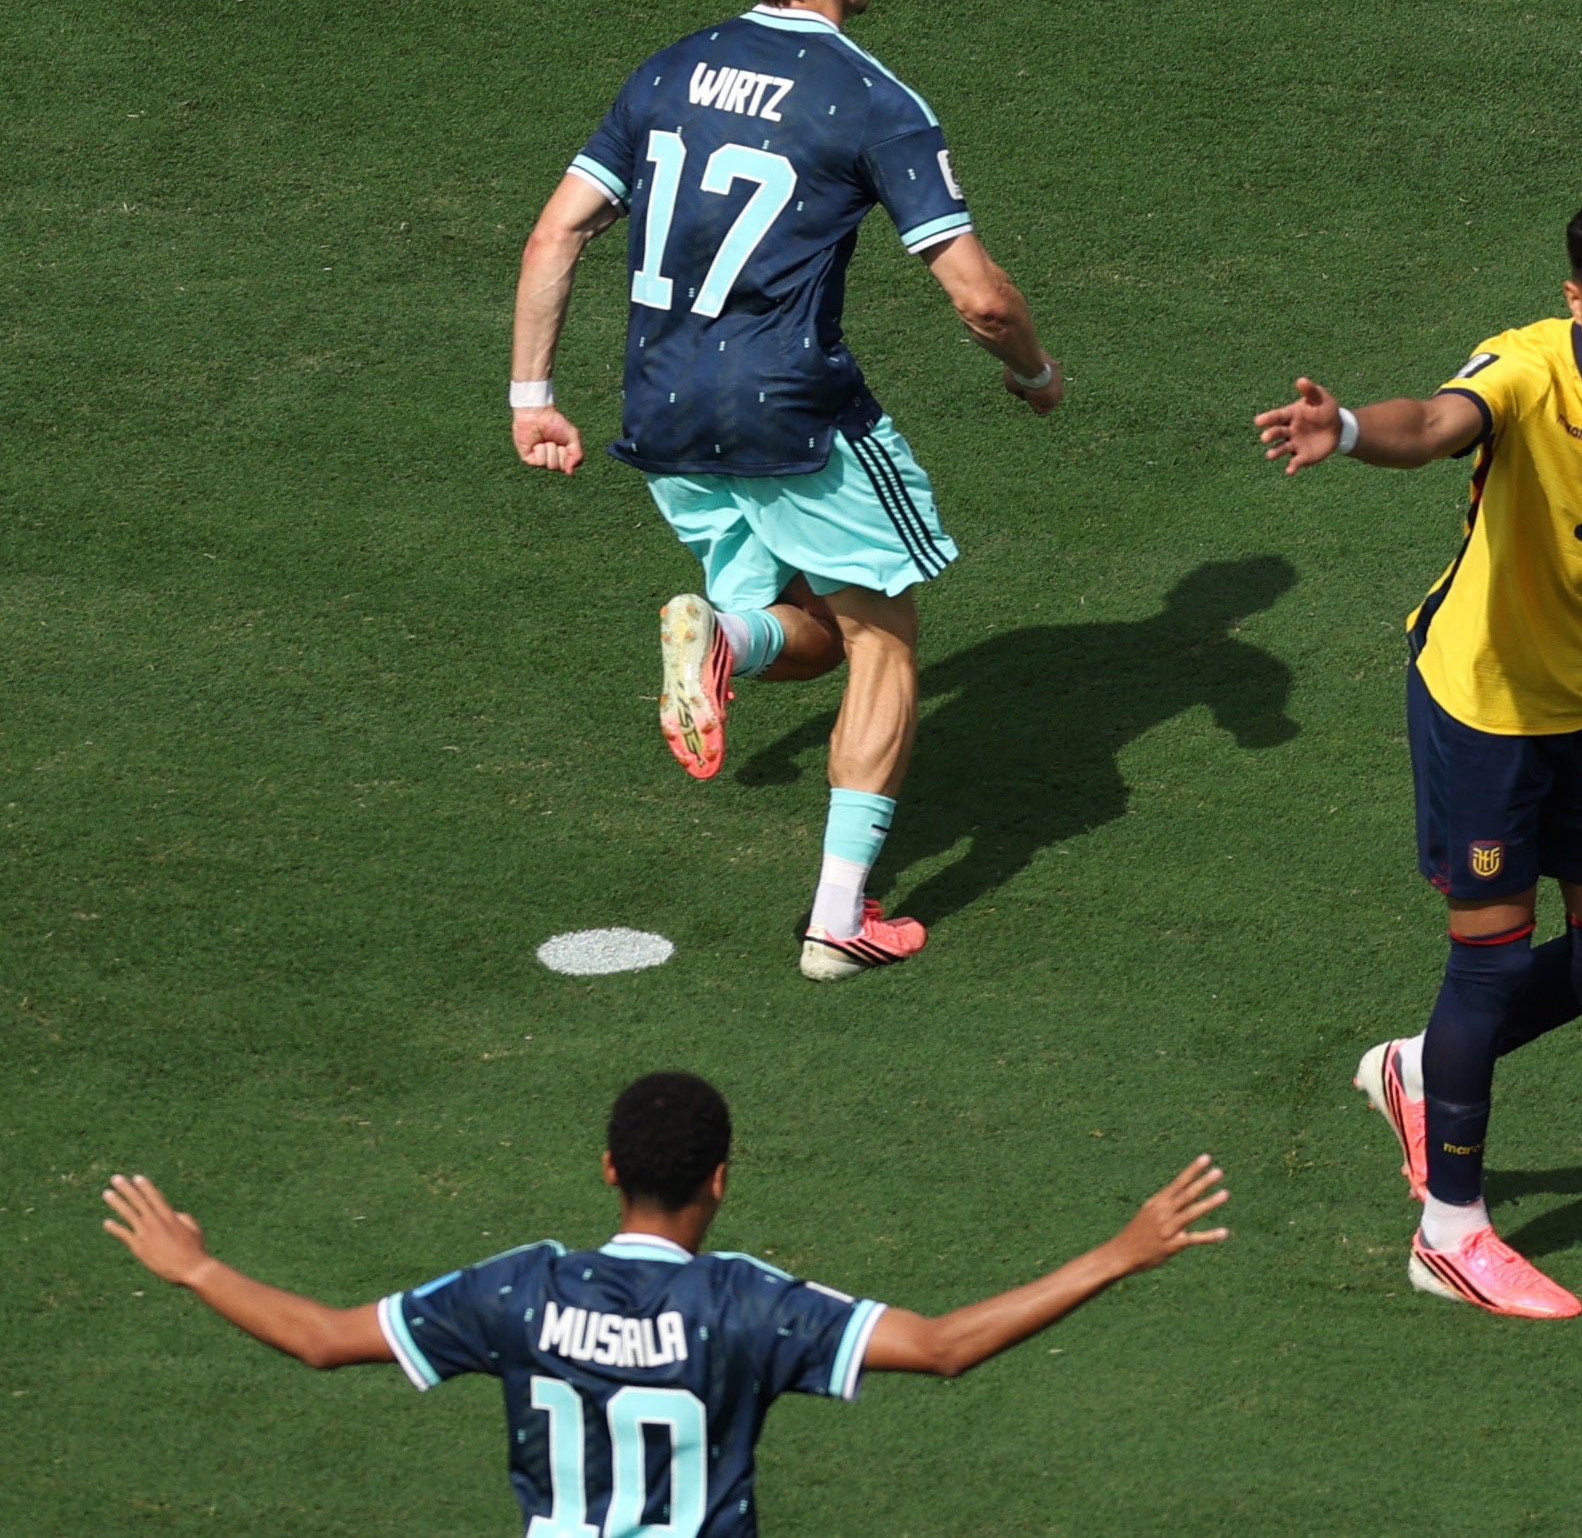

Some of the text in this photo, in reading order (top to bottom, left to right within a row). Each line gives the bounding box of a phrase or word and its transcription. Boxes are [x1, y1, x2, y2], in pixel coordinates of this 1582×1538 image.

[689, 63, 793, 122] WIRTZ
[631, 130, 797, 319] 17
[524, 1375, 707, 1538] 10
